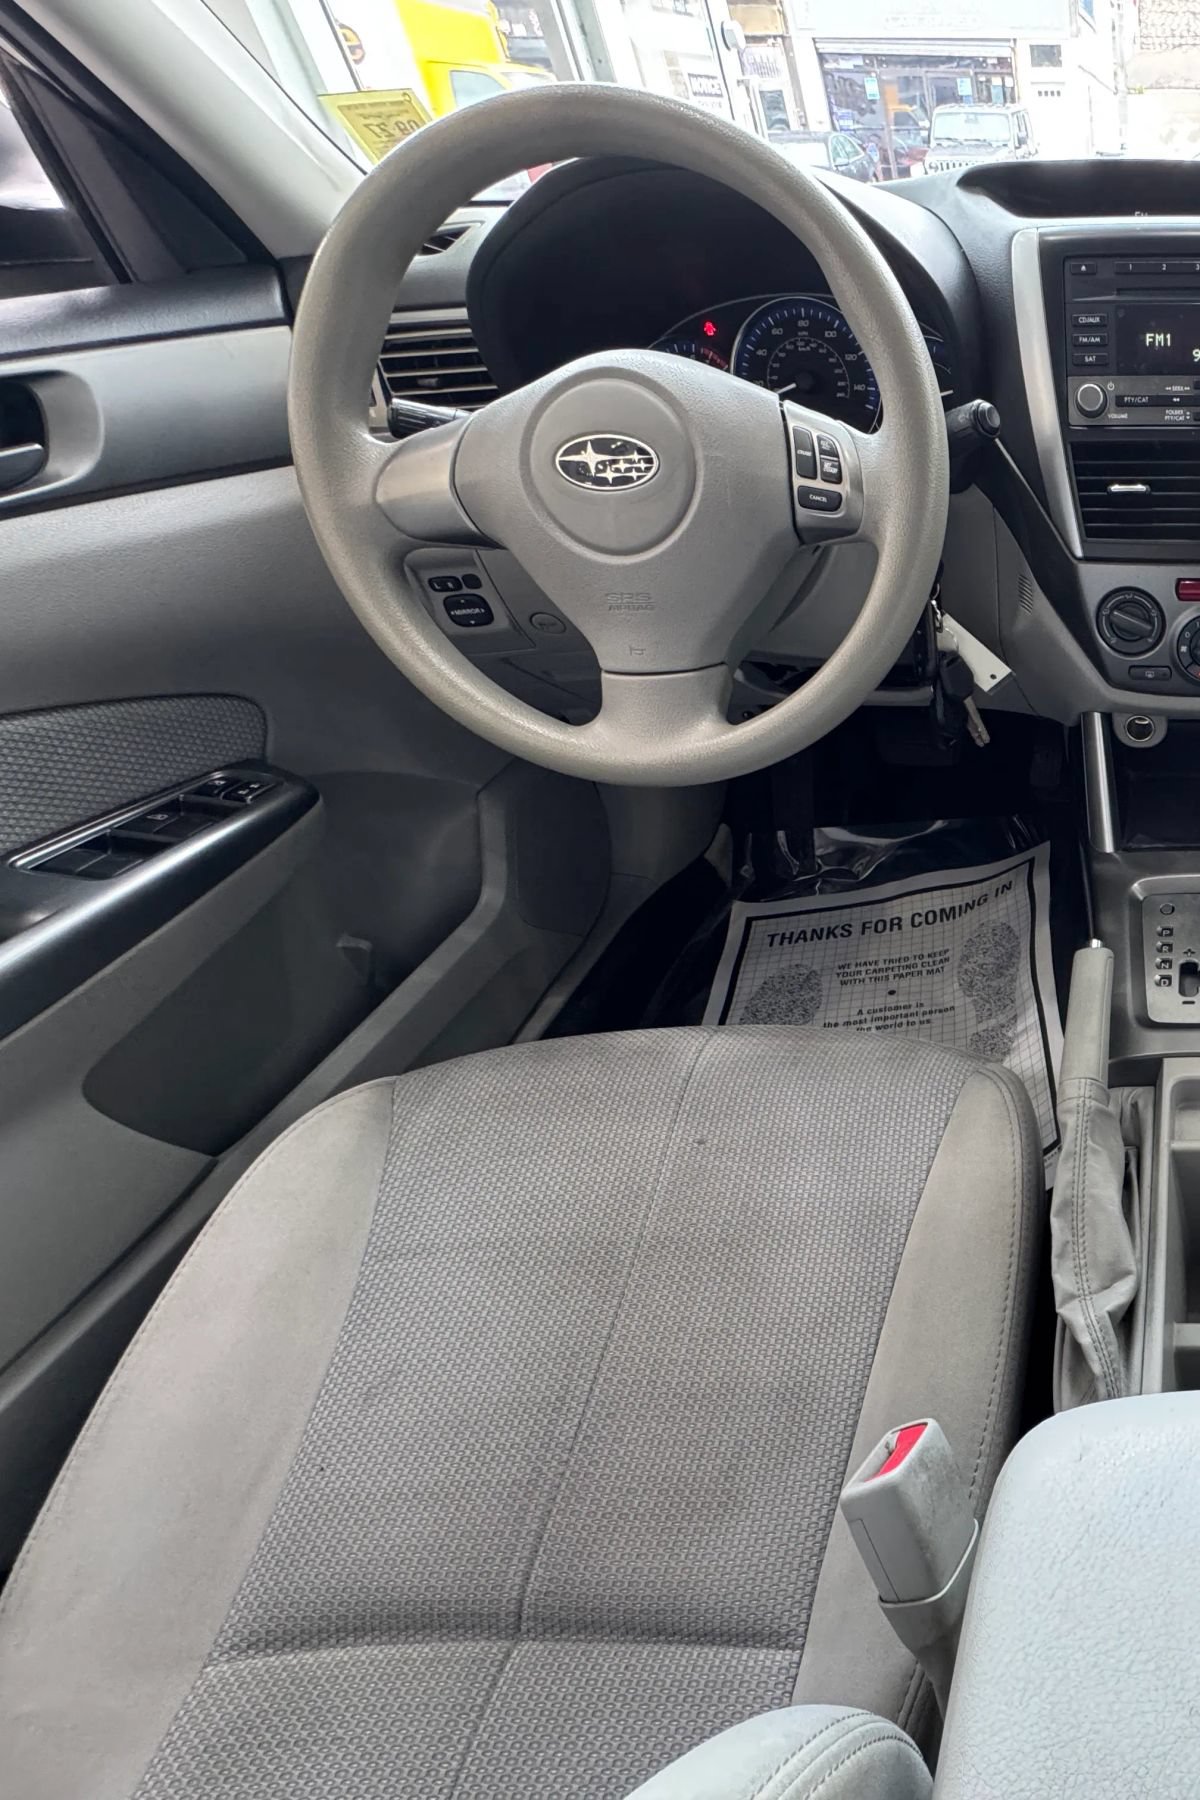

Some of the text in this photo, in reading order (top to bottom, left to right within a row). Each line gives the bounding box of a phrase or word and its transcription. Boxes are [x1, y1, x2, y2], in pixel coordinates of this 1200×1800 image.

[1145, 333, 1171, 347] FM1
[767, 880, 1012, 947] THANKS FOR COMING IN
[836, 957, 950, 978] YOUR CARPETING CLEAN
[838, 948, 949, 970] WE HAVE TRIED TO KEEP
[840, 966, 945, 986] WITH THIS PAPER MAT
[842, 1017, 867, 1026] most
[871, 1010, 918, 1023] important
[921, 1005, 955, 1017] person
[867, 1003, 912, 1015] customer
[875, 1021, 903, 1031] world
[906, 1019, 916, 1027] to
